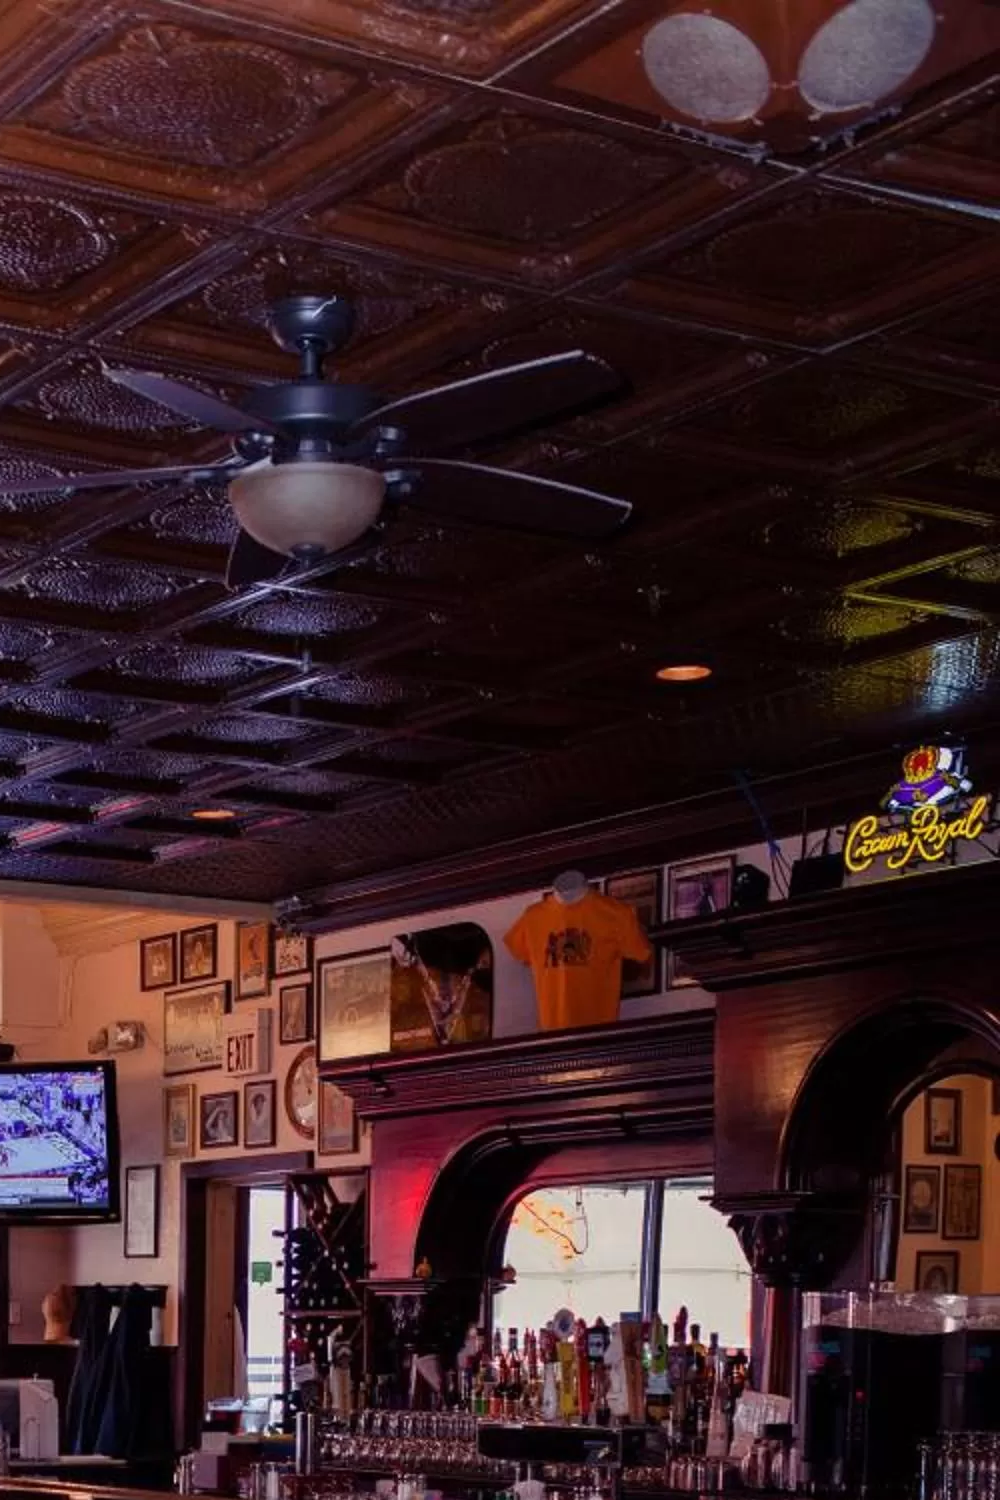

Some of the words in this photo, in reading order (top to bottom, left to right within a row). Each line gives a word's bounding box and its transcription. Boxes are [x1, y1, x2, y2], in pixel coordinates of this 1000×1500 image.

[845, 816, 909, 872] Crown
[887, 796, 987, 869] Royal
[227, 1034, 254, 1072] EXIT
